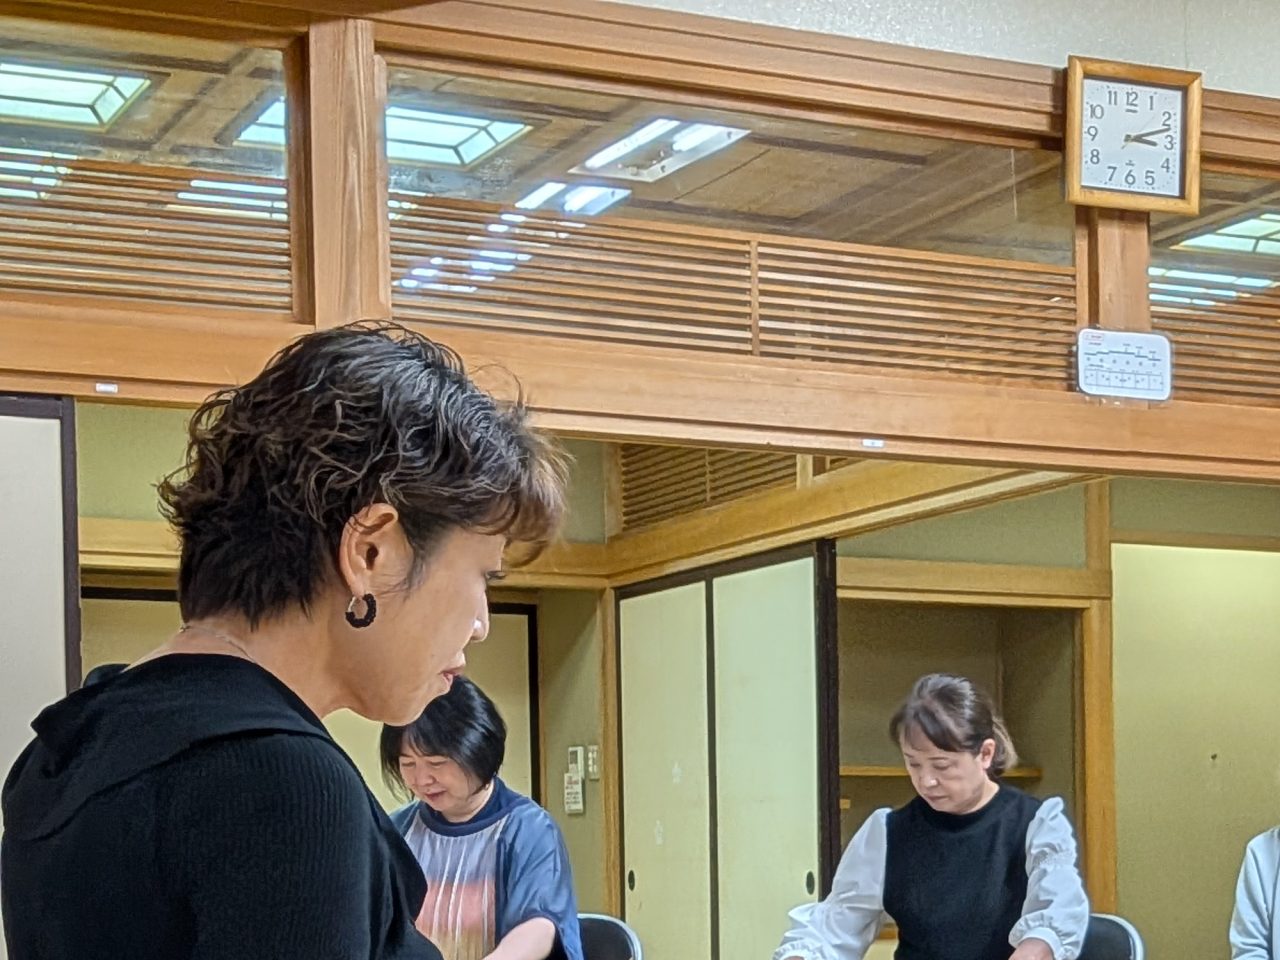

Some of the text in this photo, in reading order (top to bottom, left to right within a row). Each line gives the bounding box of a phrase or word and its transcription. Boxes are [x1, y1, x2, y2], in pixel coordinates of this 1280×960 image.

[1108, 90, 1117, 105] 11
[1126, 91, 1138, 107] 12
[1149, 95, 1154, 110] 1
[1090, 104, 1104, 119] 10
[1162, 111, 1172, 127] 2
[1087, 126, 1098, 141] 9
[1164, 134, 1174, 150] 3
[1090, 149, 1100, 165] 8
[1161, 158, 1170, 173] 4
[1107, 166, 1117, 181] 7
[1125, 169, 1136, 185] 6
[1145, 170, 1155, 186] 5
